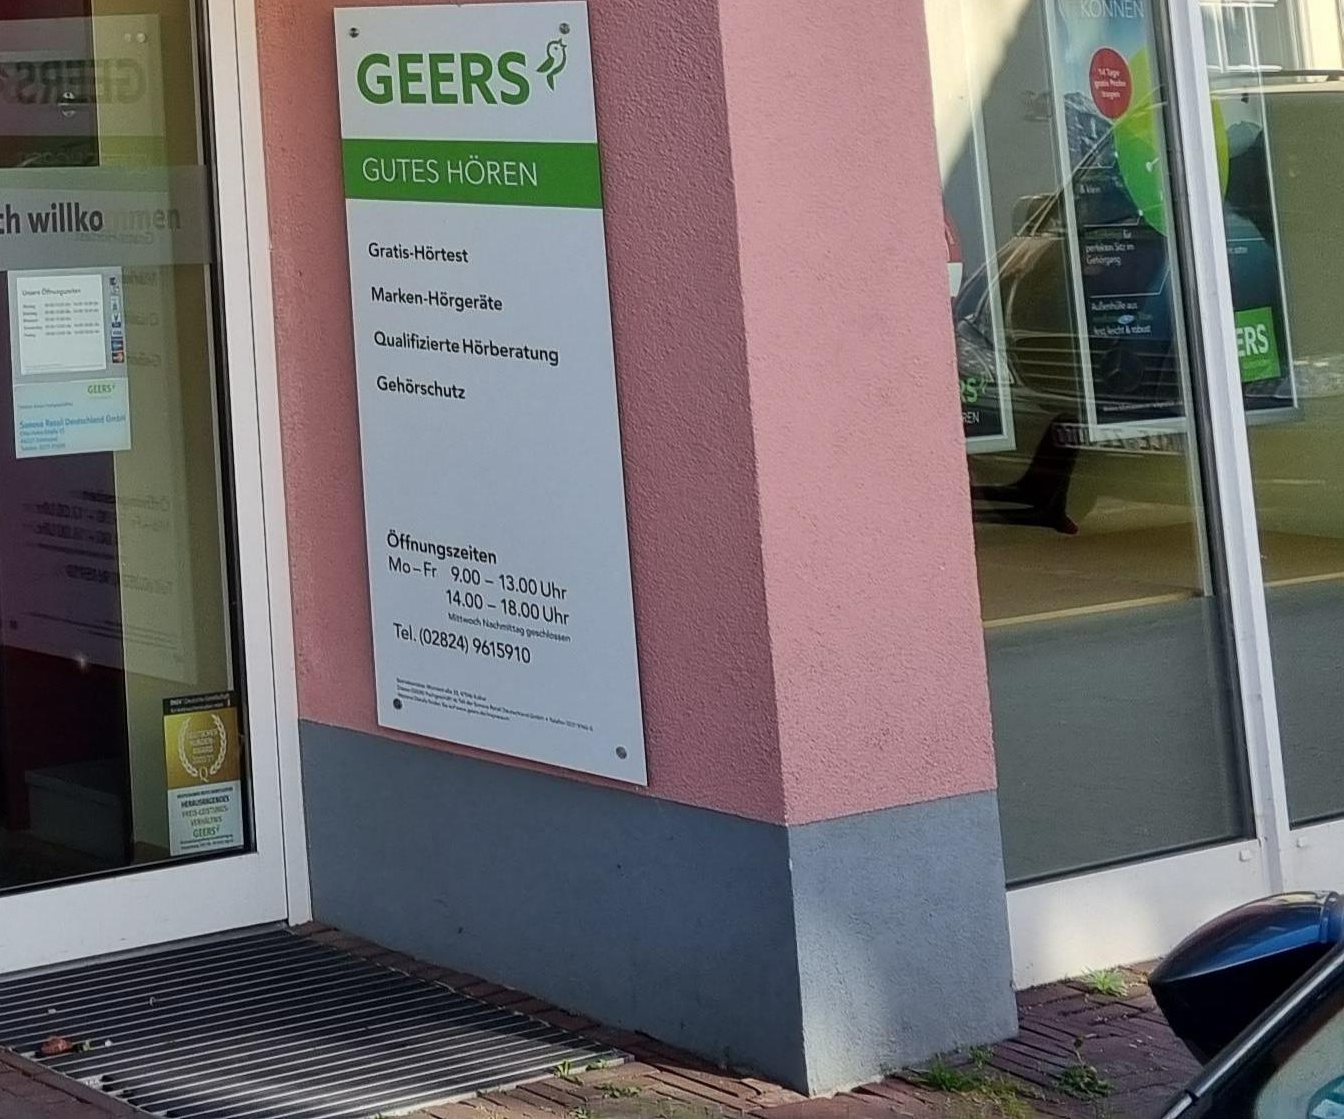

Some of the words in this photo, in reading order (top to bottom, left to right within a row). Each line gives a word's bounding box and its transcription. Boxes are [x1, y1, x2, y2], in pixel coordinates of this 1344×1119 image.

[357, 51, 530, 105] GEERS
[362, 157, 440, 184] GUTES
[447, 154, 538, 187] HÖREN
[368, 242, 469, 263] Gratis-Hörtest
[371, 286, 503, 312] Marken-Hörgeräte
[374, 331, 460, 353] Qualifizierte
[462, 338, 559, 366] Hörberatung
[87, 384, 112, 395] GEERS
[376, 375, 466, 399] Gehörschutz
[387, 529, 497, 565] Öffnungszeiten
[451, 566, 481, 586] 9.00
[499, 574, 537, 595] 13.00
[540, 580, 567, 600] Uhr
[446, 589, 483, 610] 14.00
[501, 599, 540, 620] 18.00
[542, 605, 569, 625] Uhr
[393, 622, 416, 642] Tel.
[419, 628, 469, 654] (02824)
[472, 638, 531, 663] 9615910
[448, 612, 481, 627] Mittwoch
[482, 619, 525, 637] Nachmittag
[526, 627, 571, 642] geschlossen
[193, 827, 216, 838] GEERS
